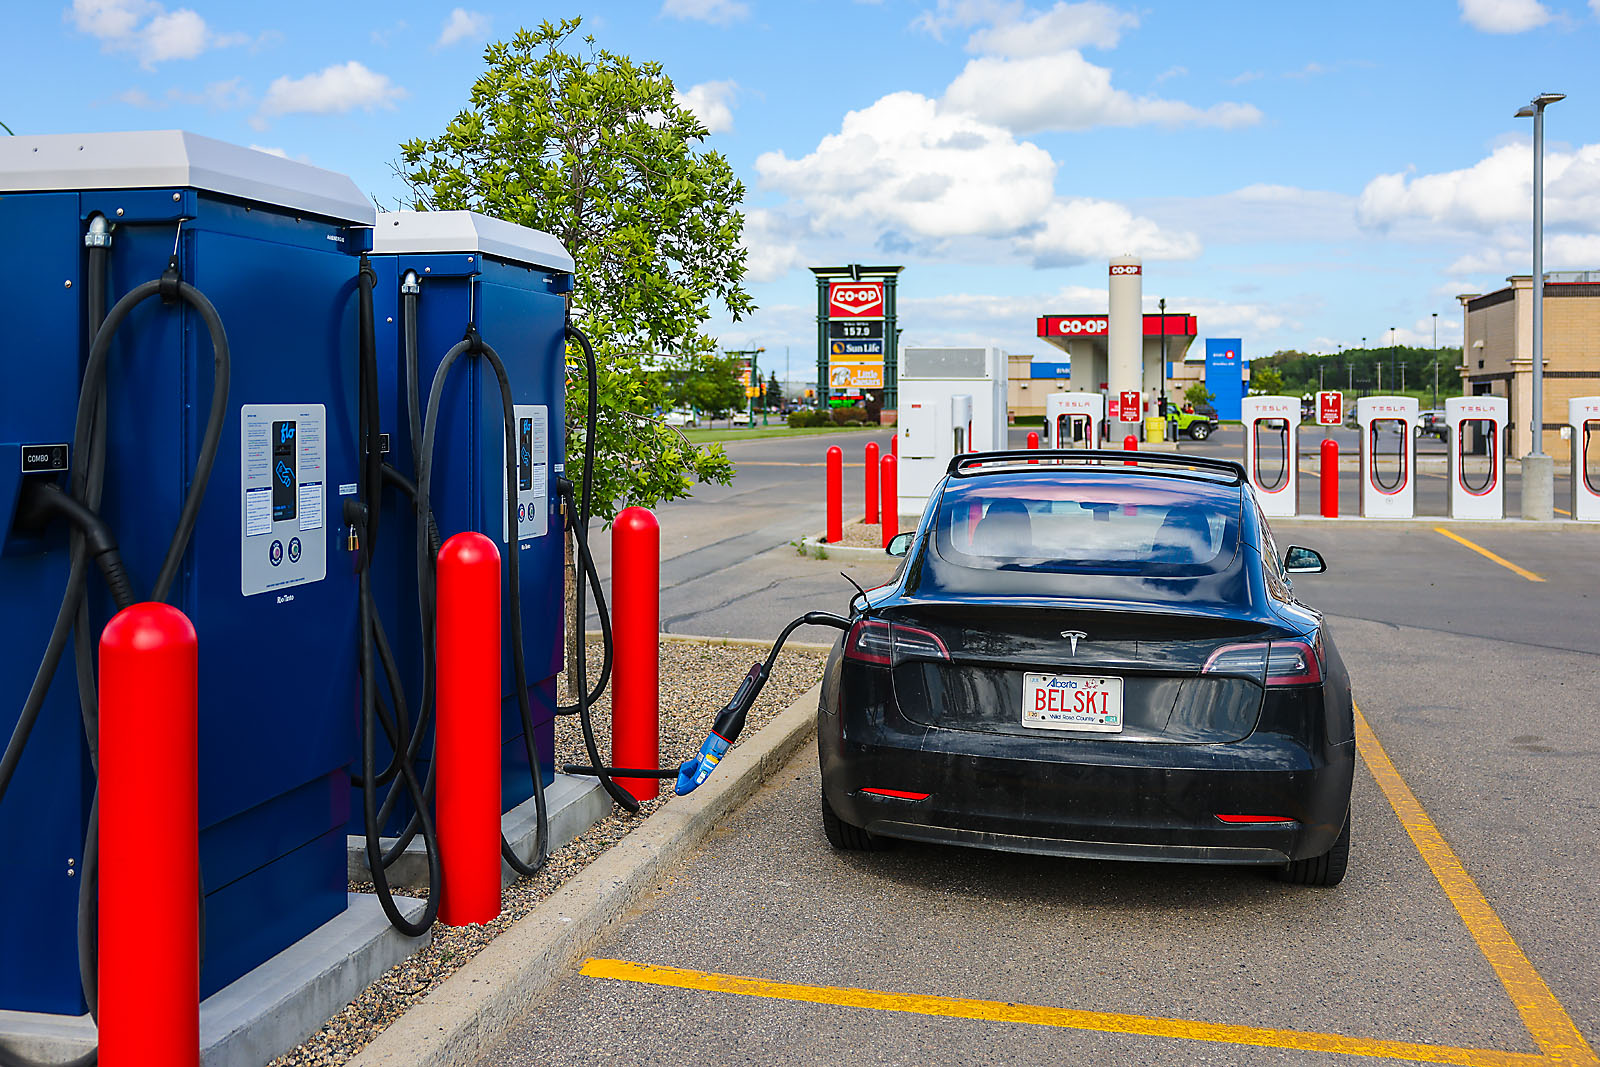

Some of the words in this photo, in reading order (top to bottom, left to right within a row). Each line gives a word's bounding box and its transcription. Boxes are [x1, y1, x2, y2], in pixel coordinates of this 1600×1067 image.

[1112, 266, 1138, 274] CO-OP
[836, 290, 877, 302] CO-OP
[844, 327, 870, 336] 157.9
[1059, 320, 1107, 333] CO-OP
[846, 343, 863, 353] Sun
[864, 343, 880, 353] Life
[280, 421, 295, 443] flo
[27, 454, 49, 463] COMBO
[1046, 677, 1078, 689] Alberta
[1035, 688, 1109, 714] BELSKI
